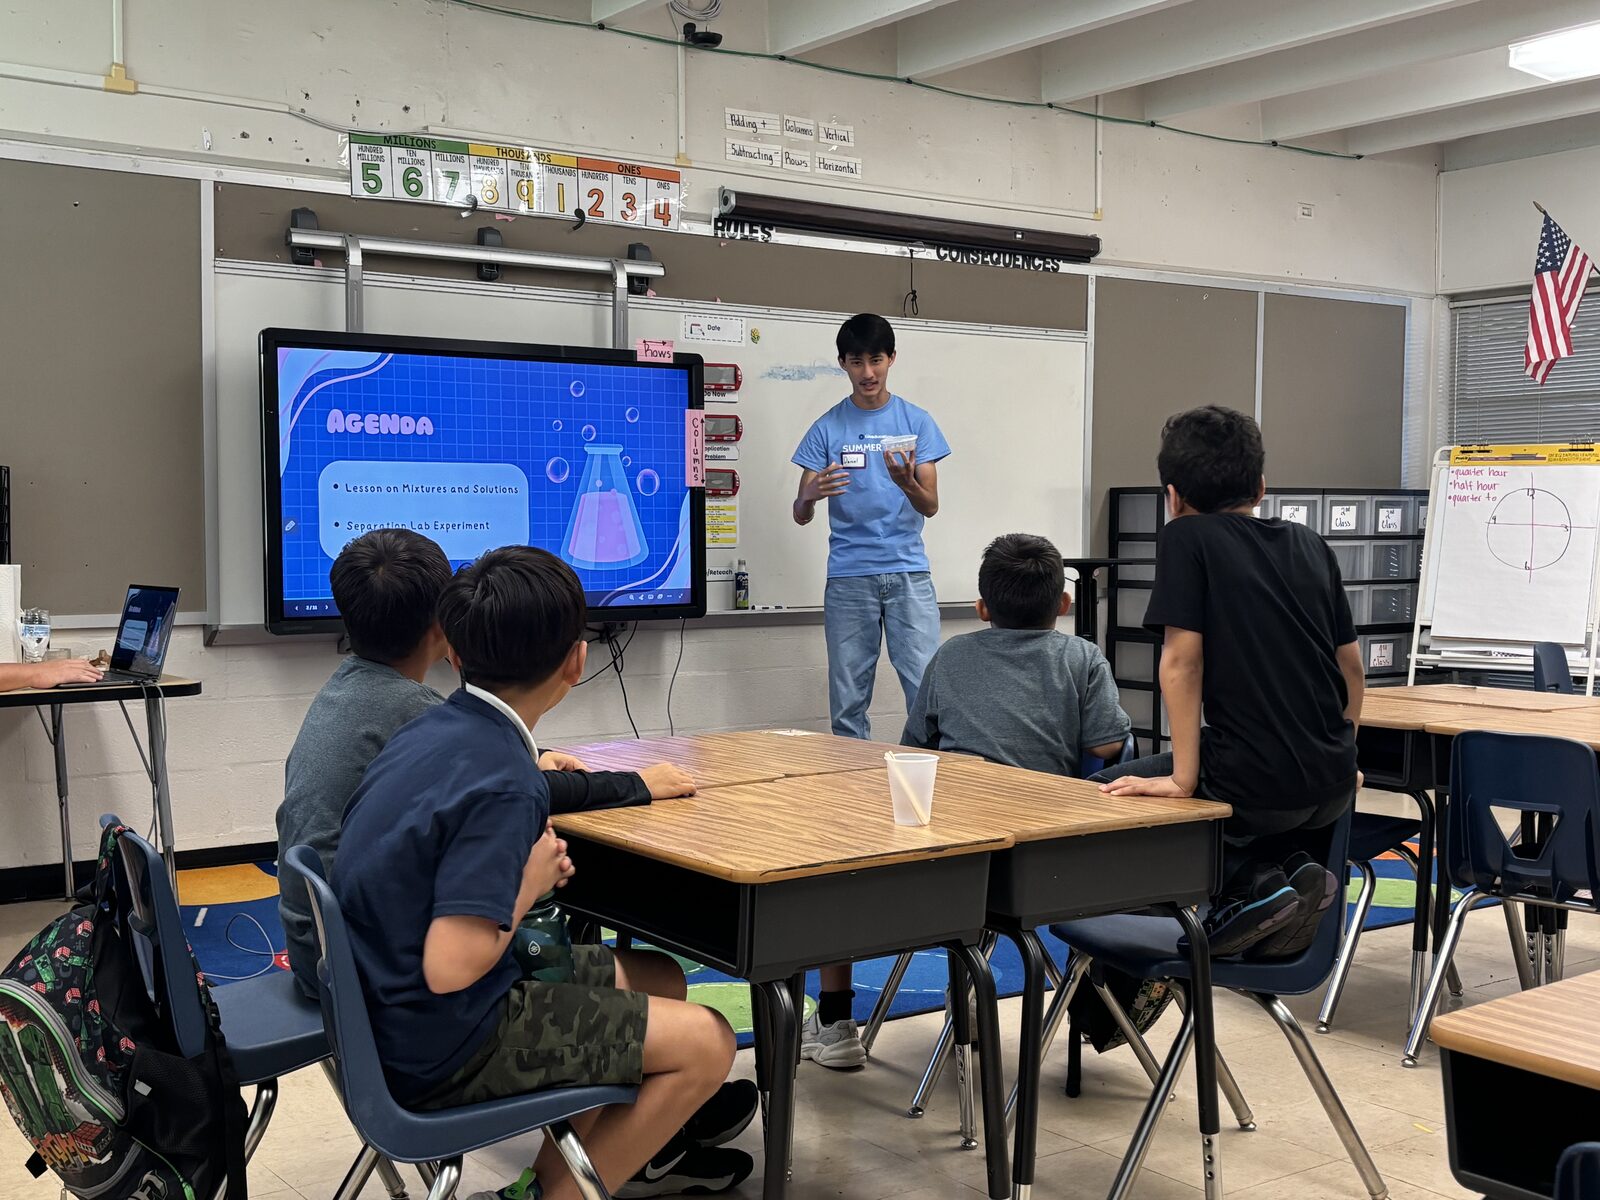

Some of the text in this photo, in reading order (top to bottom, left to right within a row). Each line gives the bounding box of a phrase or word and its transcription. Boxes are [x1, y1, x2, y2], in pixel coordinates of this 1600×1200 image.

[730, 114, 758, 133] Adding
[785, 118, 813, 136] Columns
[823, 127, 850, 143] Vertical
[383, 136, 437, 149] MILLIONS
[358, 145, 383, 154] HUNDRED
[405, 149, 417, 158] TEN
[731, 143, 774, 165] Subtracting
[357, 153, 386, 163] MILLIONS
[435, 153, 465, 164] MILLIONS
[496, 148, 552, 163] THOUSANDS
[784, 151, 808, 168] Rows
[397, 157, 426, 166] MILLIONS
[476, 158, 500, 167] HUNDRED
[818, 157, 858, 174] Horizontal
[510, 169, 539, 180] THOUSAN
[544, 165, 577, 178] THOUSANDS
[617, 164, 641, 176] ONES
[581, 171, 609, 182] HUNDREDS
[622, 176, 637, 186] TENS
[656, 181, 671, 191] ONES
[361, 162, 383, 195] 5
[402, 166, 424, 197] 6
[442, 170, 460, 200] 7
[481, 175, 500, 205] 8
[557, 182, 565, 213] 1
[587, 188, 605, 218] 2
[620, 192, 638, 221] 3
[654, 198, 671, 227] 4
[714, 217, 774, 243] RULES
[936, 245, 1061, 273] CONSEQUENCES
[707, 323, 721, 331] Date
[643, 343, 672, 358] Rows
[326, 408, 434, 436] AGENDA
[842, 443, 882, 452] SUMMER
[1454, 468, 1508, 479] quarter hour
[345, 483, 519, 494] Lesson on Mixtures and Solutions
[1453, 480, 1500, 491] half hour
[1452, 492, 1497, 507] quarter to
[346, 521, 490, 533] Separation Lab Experiment
[1335, 518, 1351, 527] Class
[1382, 521, 1398, 529] Class
